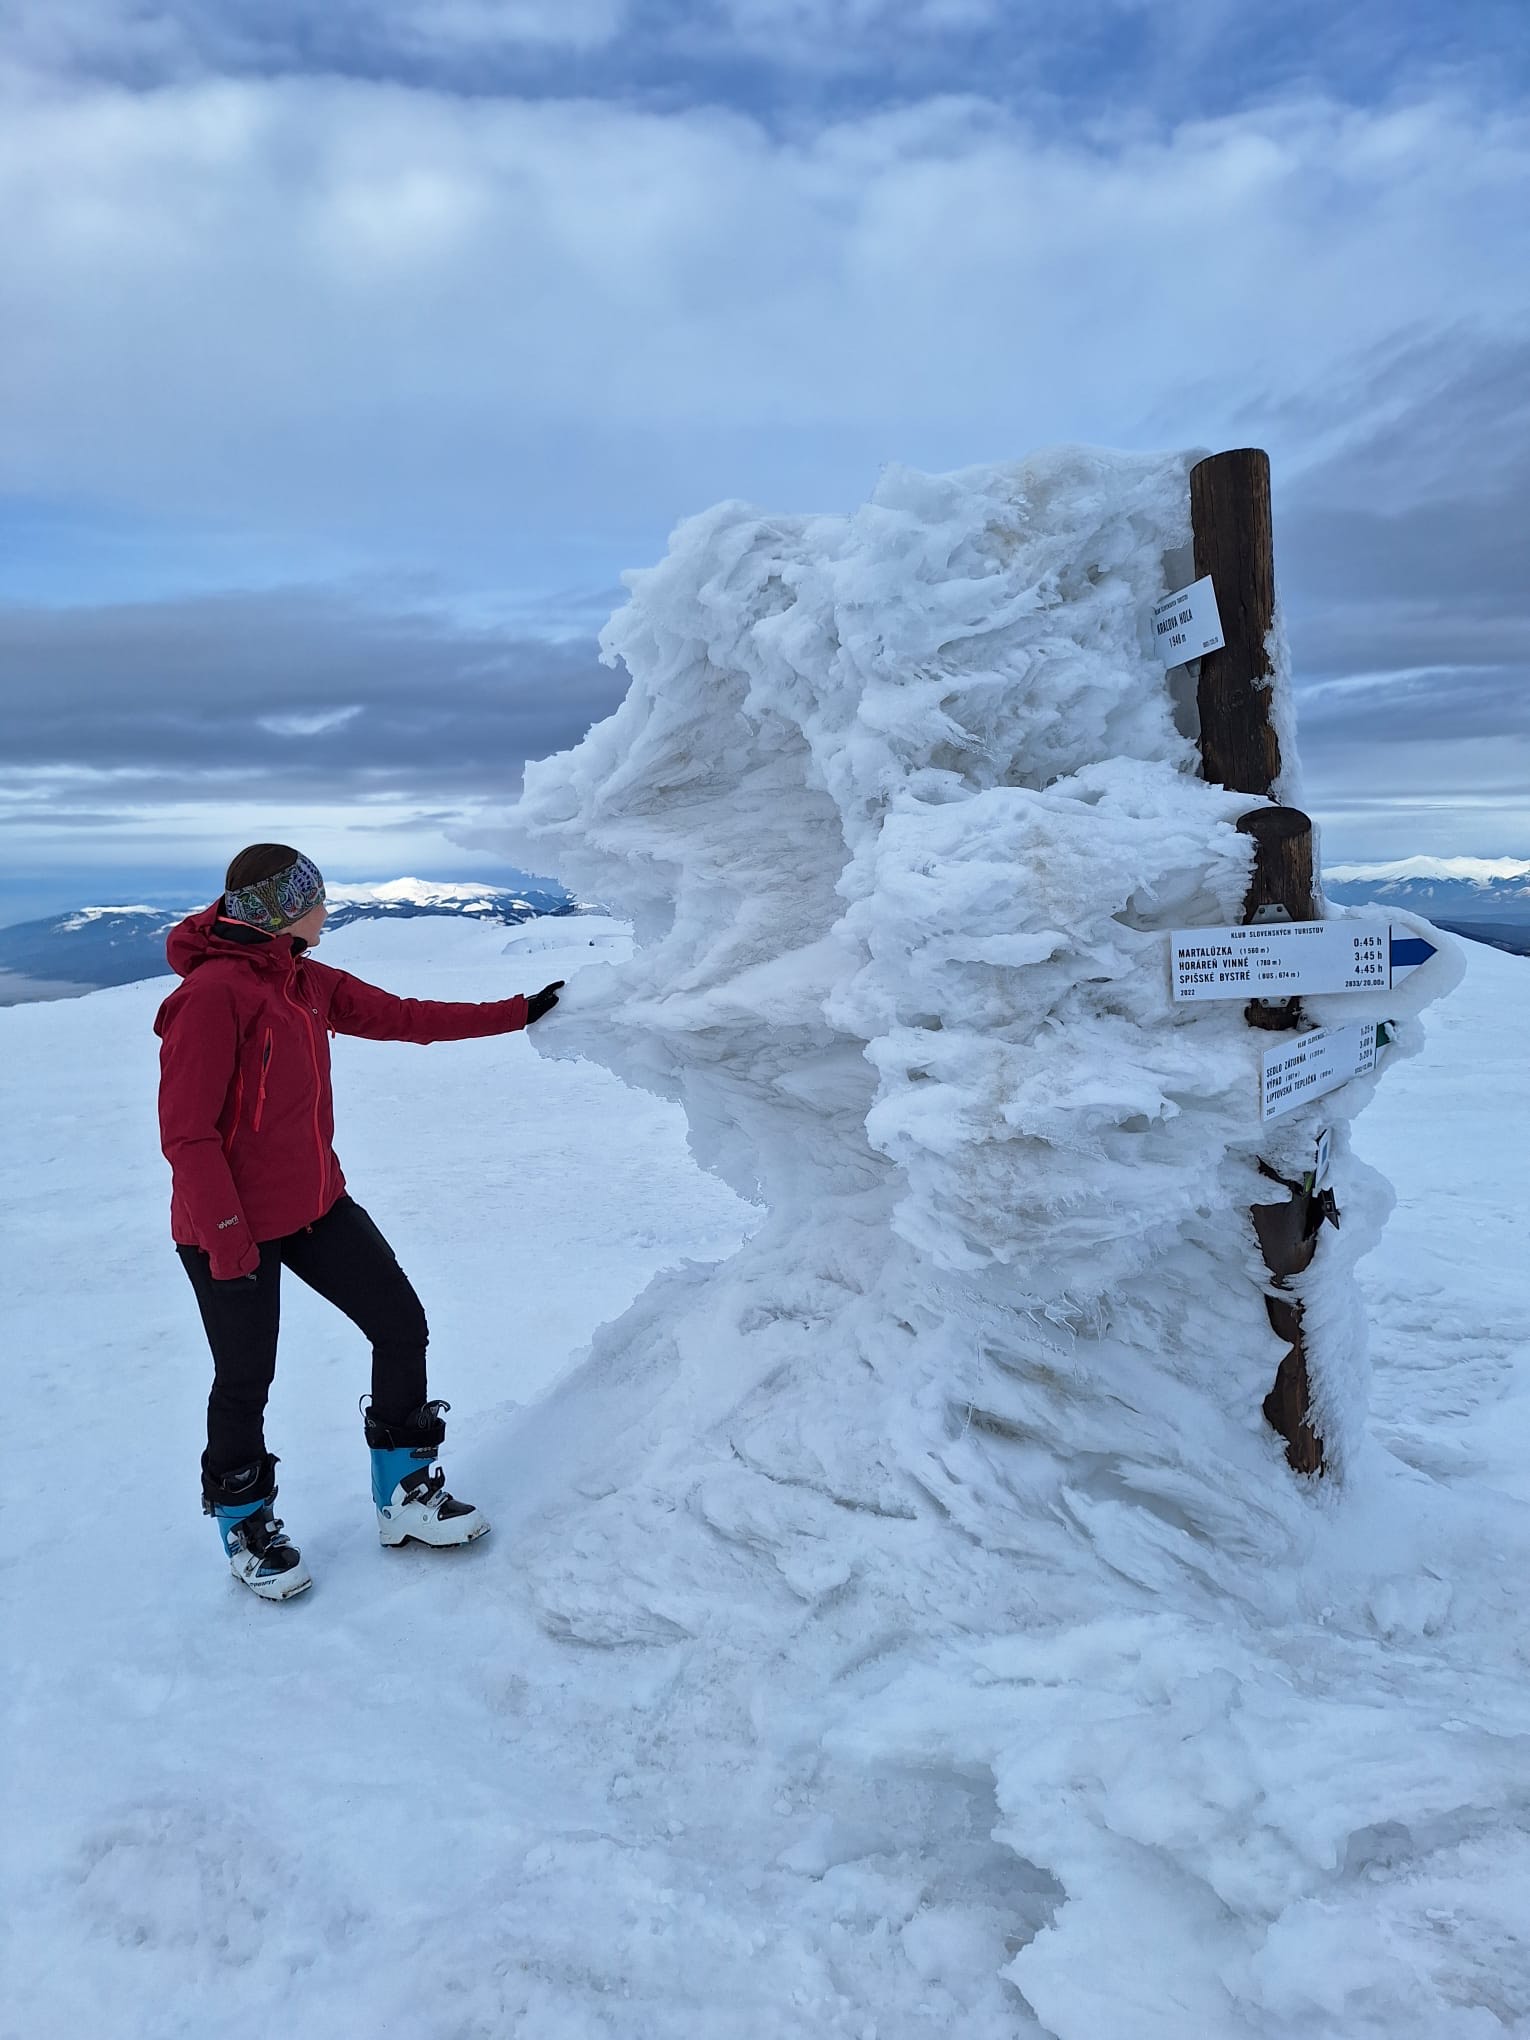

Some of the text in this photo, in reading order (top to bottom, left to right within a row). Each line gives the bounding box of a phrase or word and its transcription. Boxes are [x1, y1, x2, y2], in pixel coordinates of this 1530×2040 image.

[1231, 927, 1324, 939] KLUB SLOVENSKÝCH TURISTOV
[1353, 936, 1382, 947] 0:45 h
[1178, 945, 1233, 958] MARTALÚZKA
[1354, 950, 1383, 961] 3:45 h
[1179, 958, 1218, 971] HORÁREŇ
[1222, 956, 1249, 968] VINNÉ
[1354, 963, 1383, 975] 4:45 h
[1179, 971, 1215, 984] SPIŠSKÉ
[1219, 970, 1250, 982] BYSTRÉ
[1266, 1063, 1282, 1078] SEDLO
[1266, 1075, 1282, 1090] VÝPAD
[1266, 1084, 1292, 1104] LIPTOVSKÁ
[1294, 1074, 1317, 1090] TEPLIČKA
